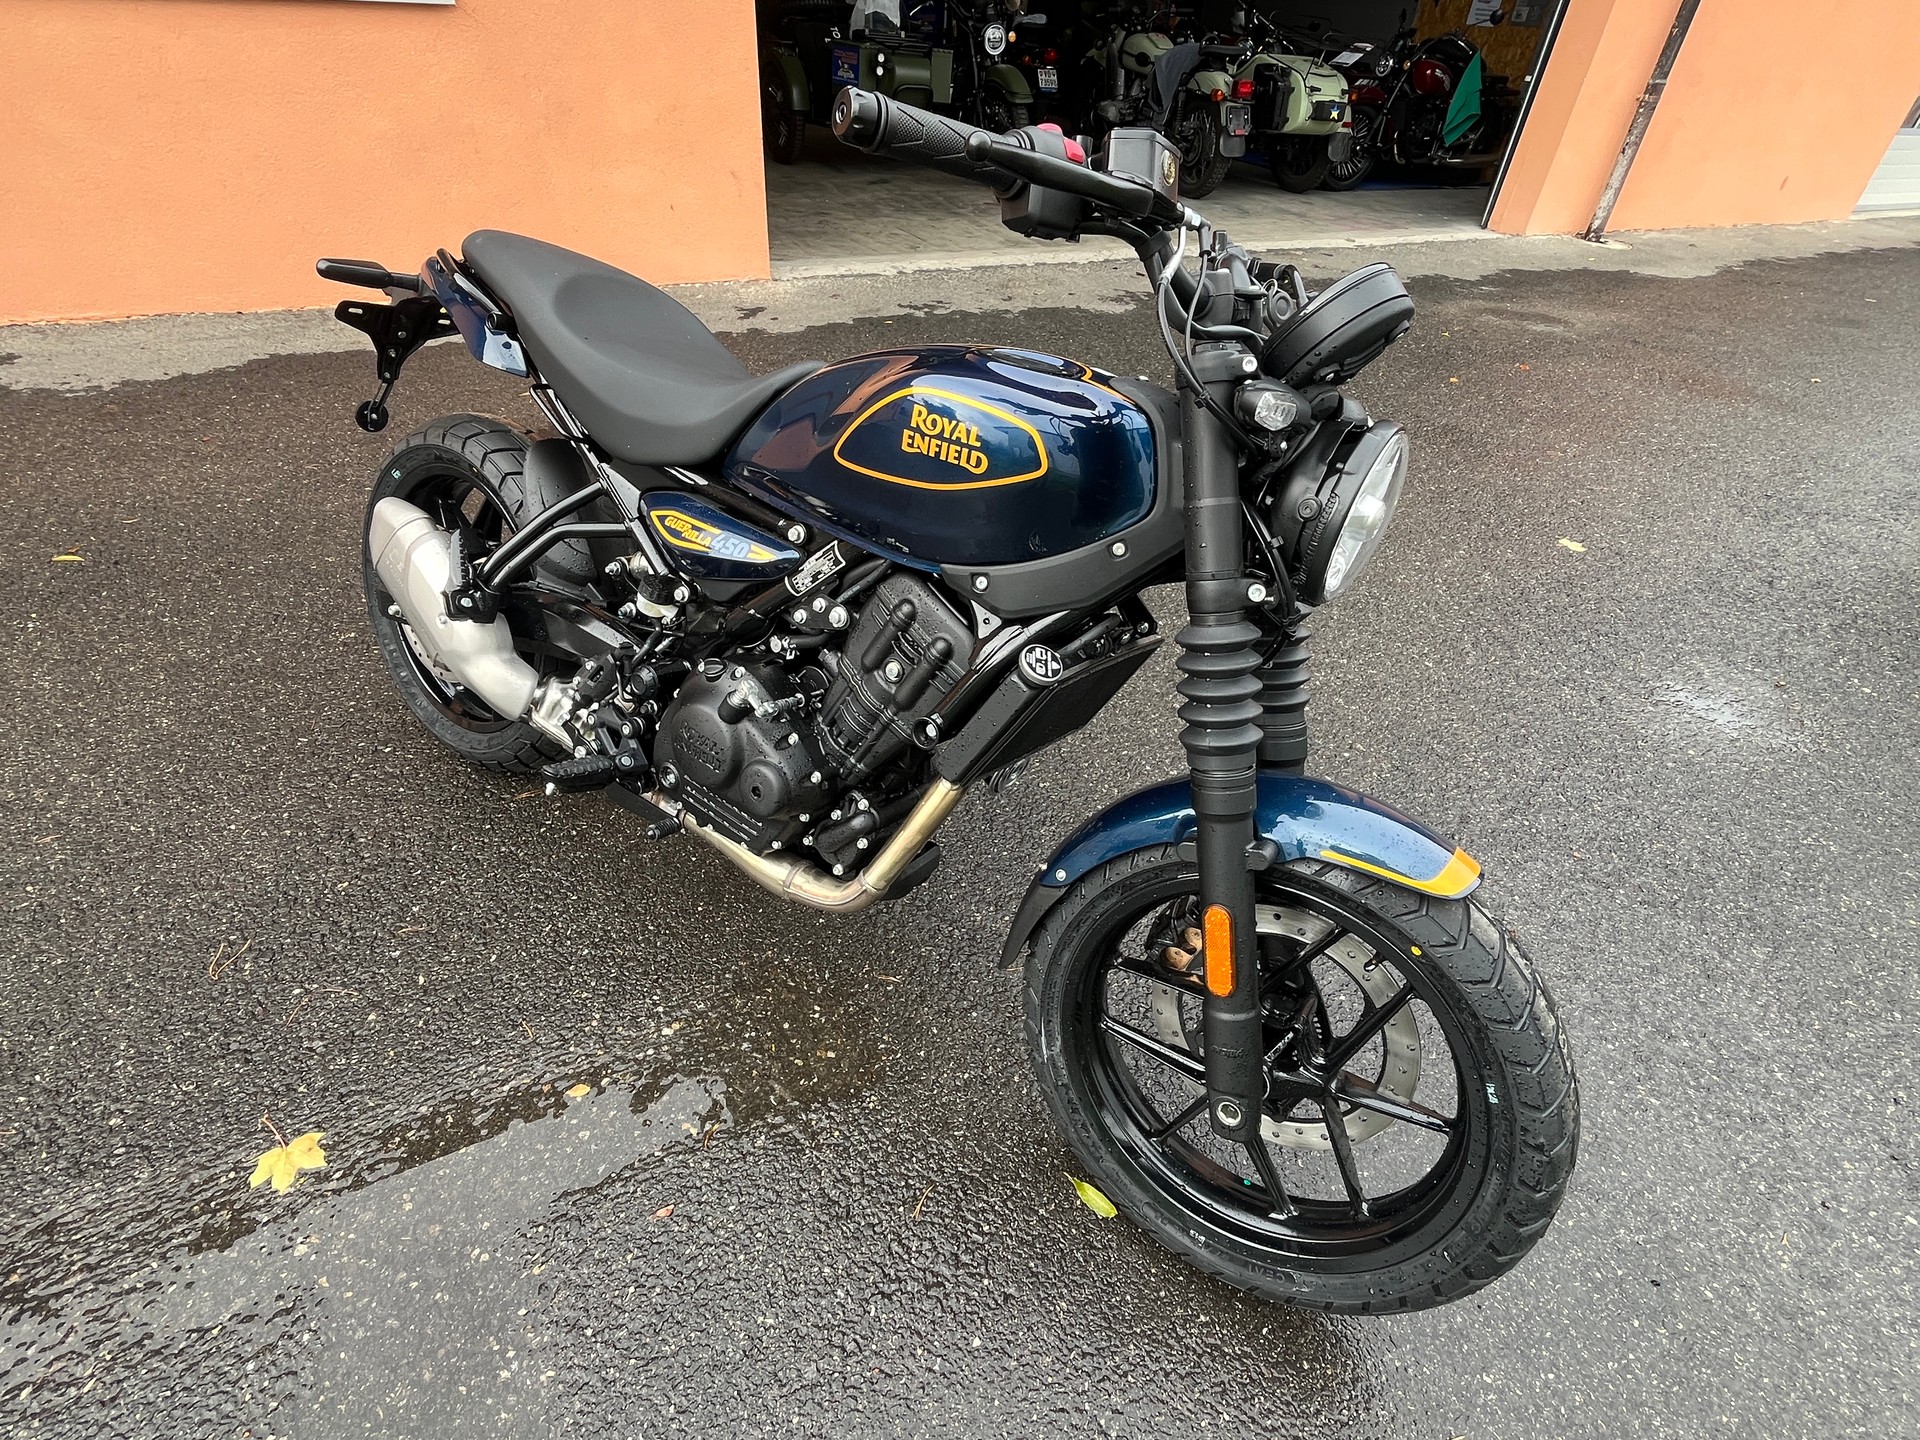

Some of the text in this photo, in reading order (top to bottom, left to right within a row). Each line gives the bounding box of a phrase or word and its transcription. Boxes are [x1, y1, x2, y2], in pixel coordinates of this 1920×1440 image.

[910, 403, 982, 448] ROYAL
[901, 429, 989, 475] ENFIELD
[709, 533, 750, 558] 450
[1248, 1263, 1286, 1284] CEAT
